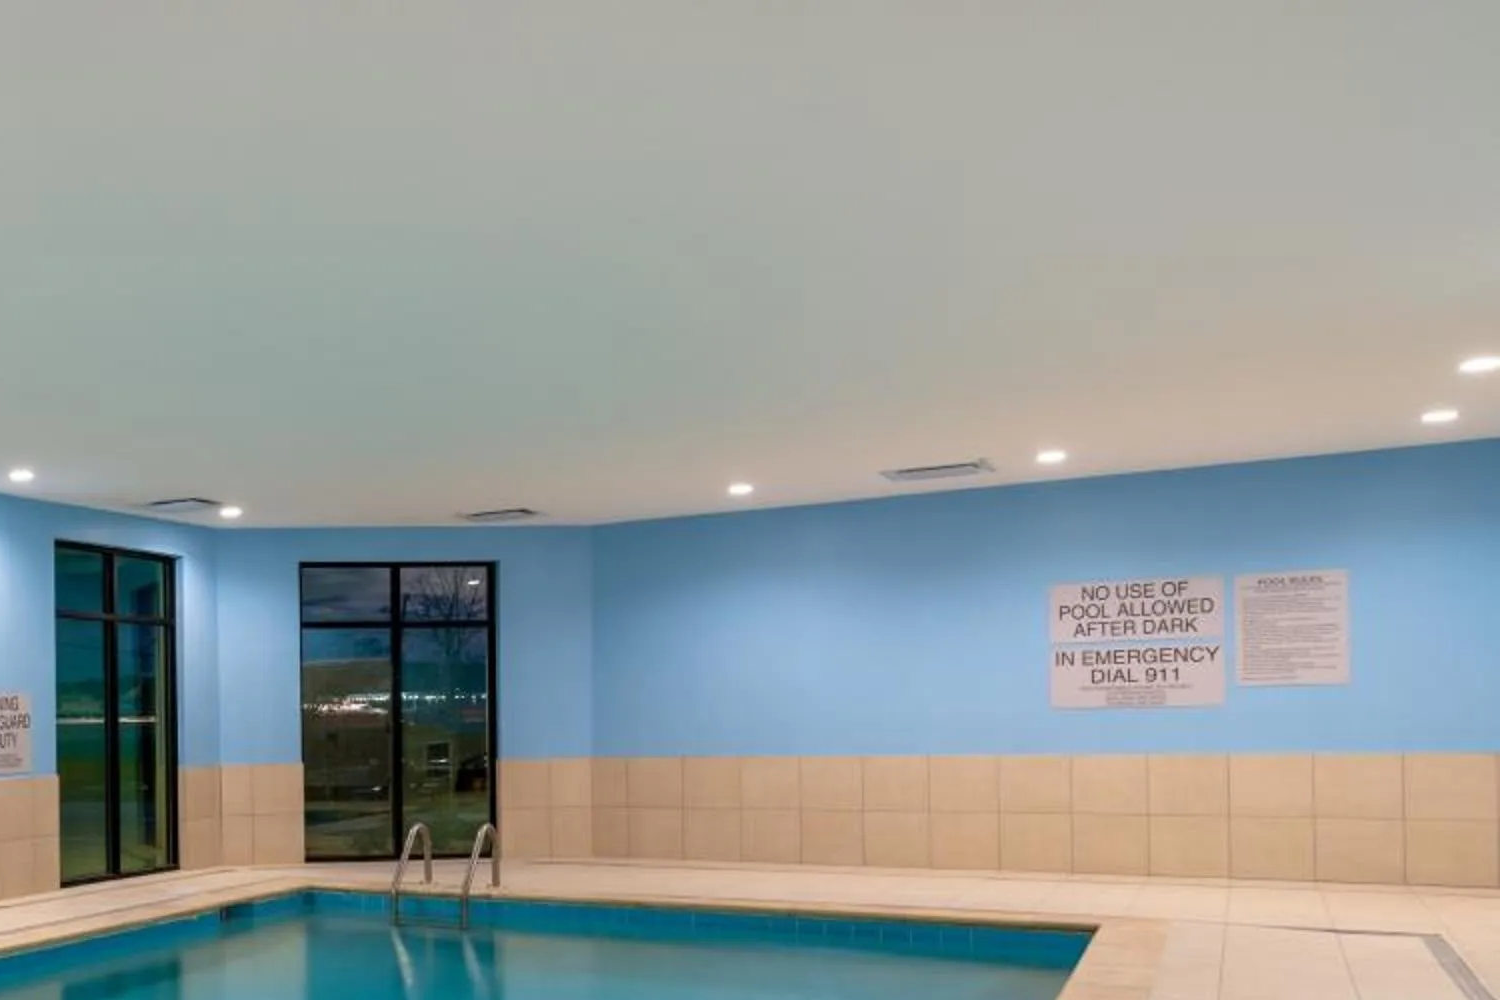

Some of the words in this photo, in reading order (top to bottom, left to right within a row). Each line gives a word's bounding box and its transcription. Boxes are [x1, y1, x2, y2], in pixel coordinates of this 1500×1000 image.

[1081, 584, 1111, 601] NO
[1115, 582, 1156, 599] USE
[1161, 580, 1189, 597] OF
[1059, 603, 1111, 621] POOL
[1117, 597, 1215, 617] ALLOWED
[1073, 619, 1137, 638] AFTER
[1142, 617, 1198, 635] DARK
[1055, 650, 1076, 667] IN
[1081, 645, 1220, 667] EMERGENCY
[1091, 667, 1139, 685] DIAL
[1145, 667, 1181, 683] 911
